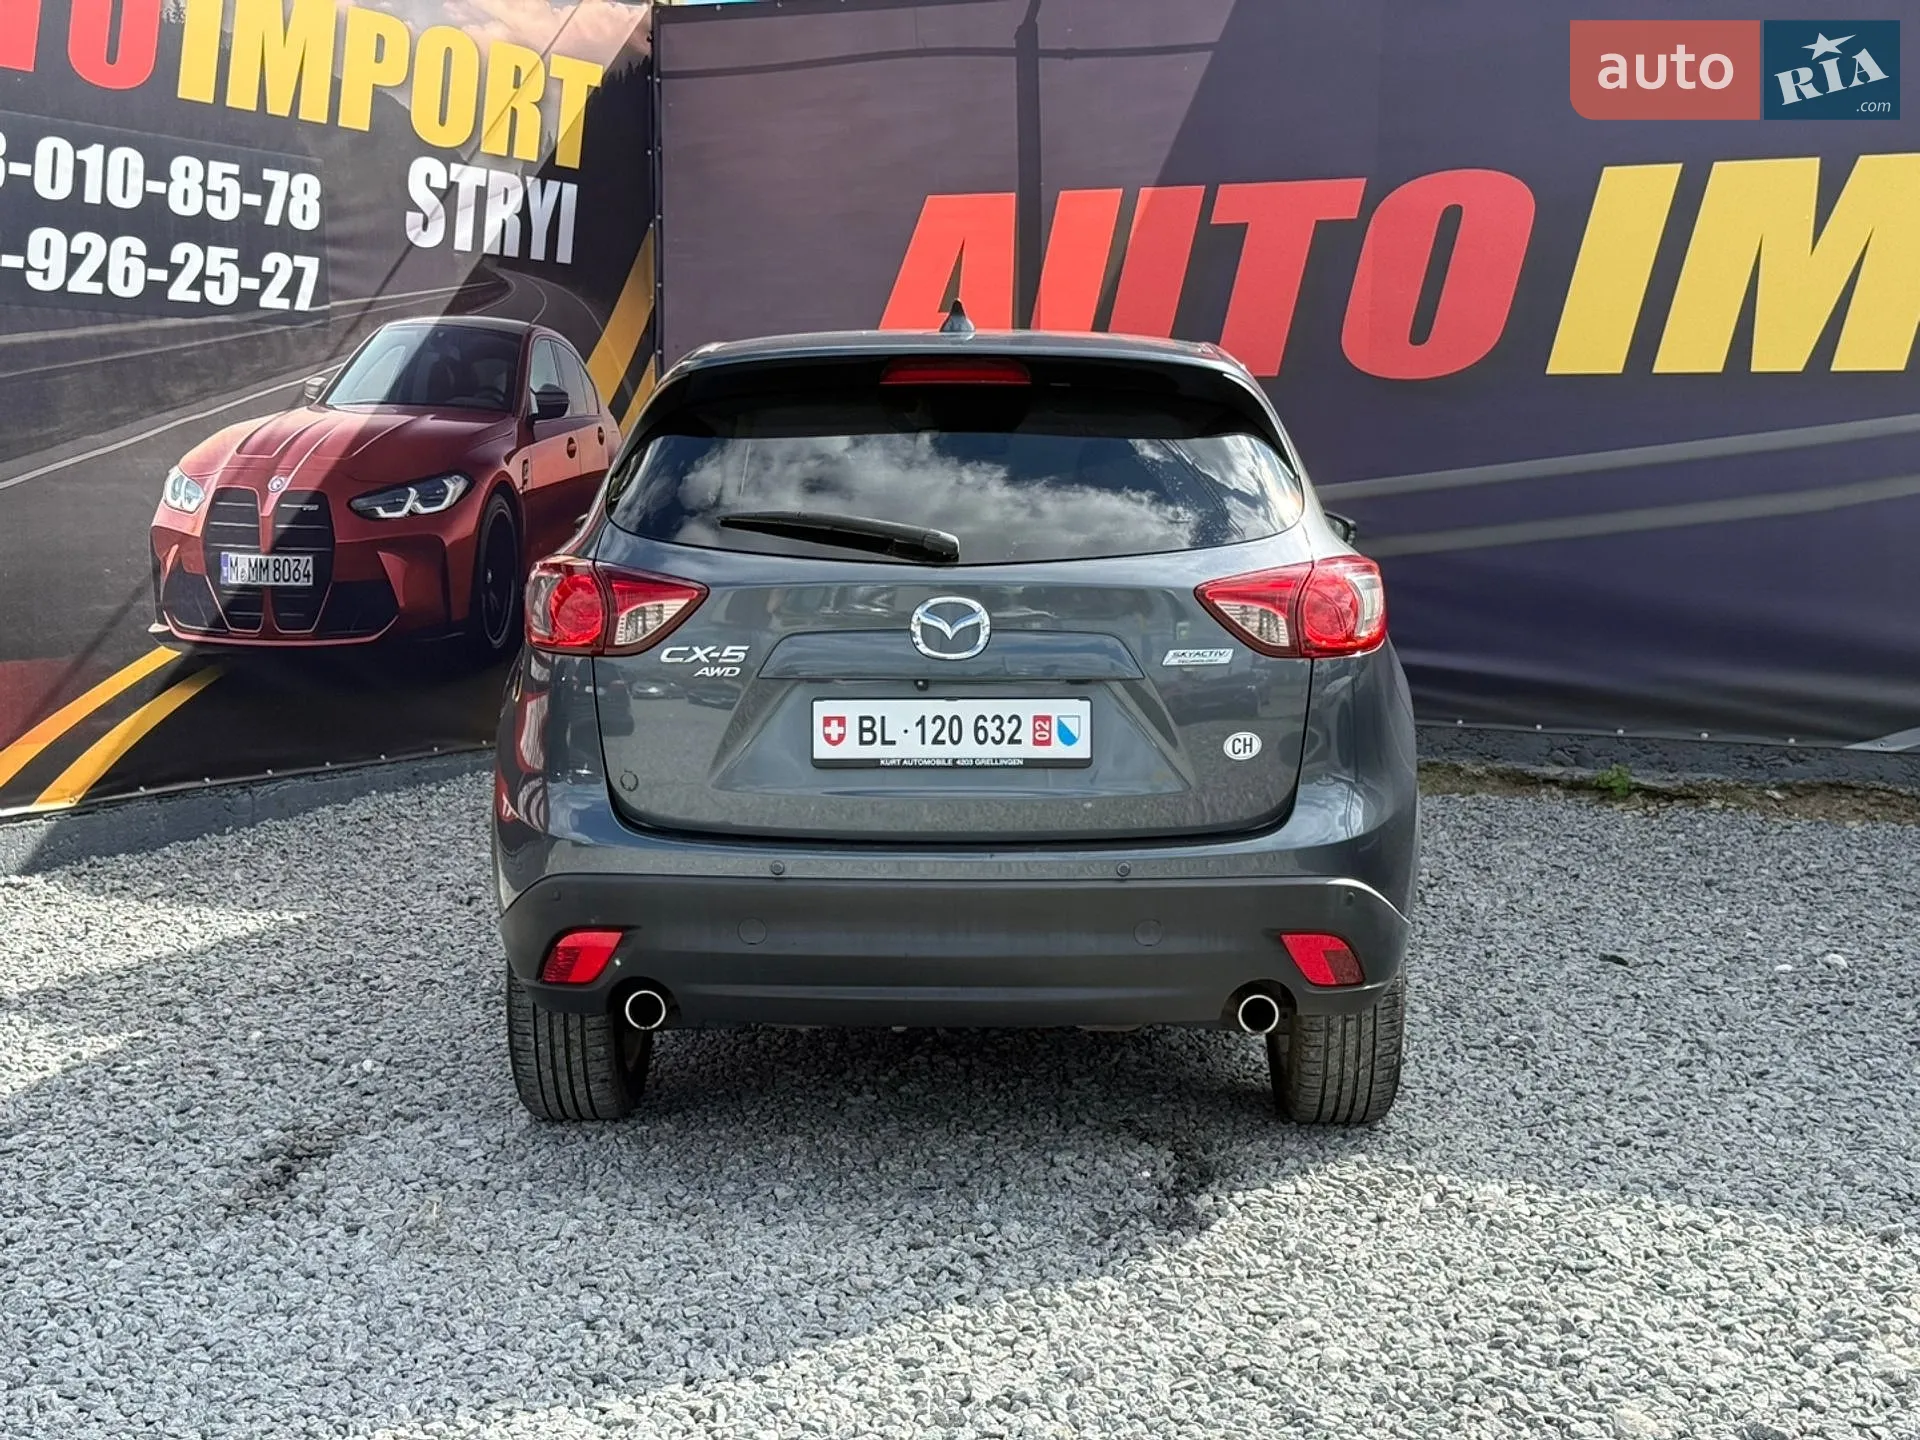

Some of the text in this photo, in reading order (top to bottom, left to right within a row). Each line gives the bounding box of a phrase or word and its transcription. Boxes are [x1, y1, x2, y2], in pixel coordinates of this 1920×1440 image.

[177, 0, 604, 170] IMPORT
[405, 156, 578, 265] STRYI
[878, 168, 1536, 380] AUTO
[660, 645, 750, 663] CX-5
[694, 666, 741, 677] AWD
[973, 714, 1022, 746] 632
[1232, 737, 1253, 755] CH
